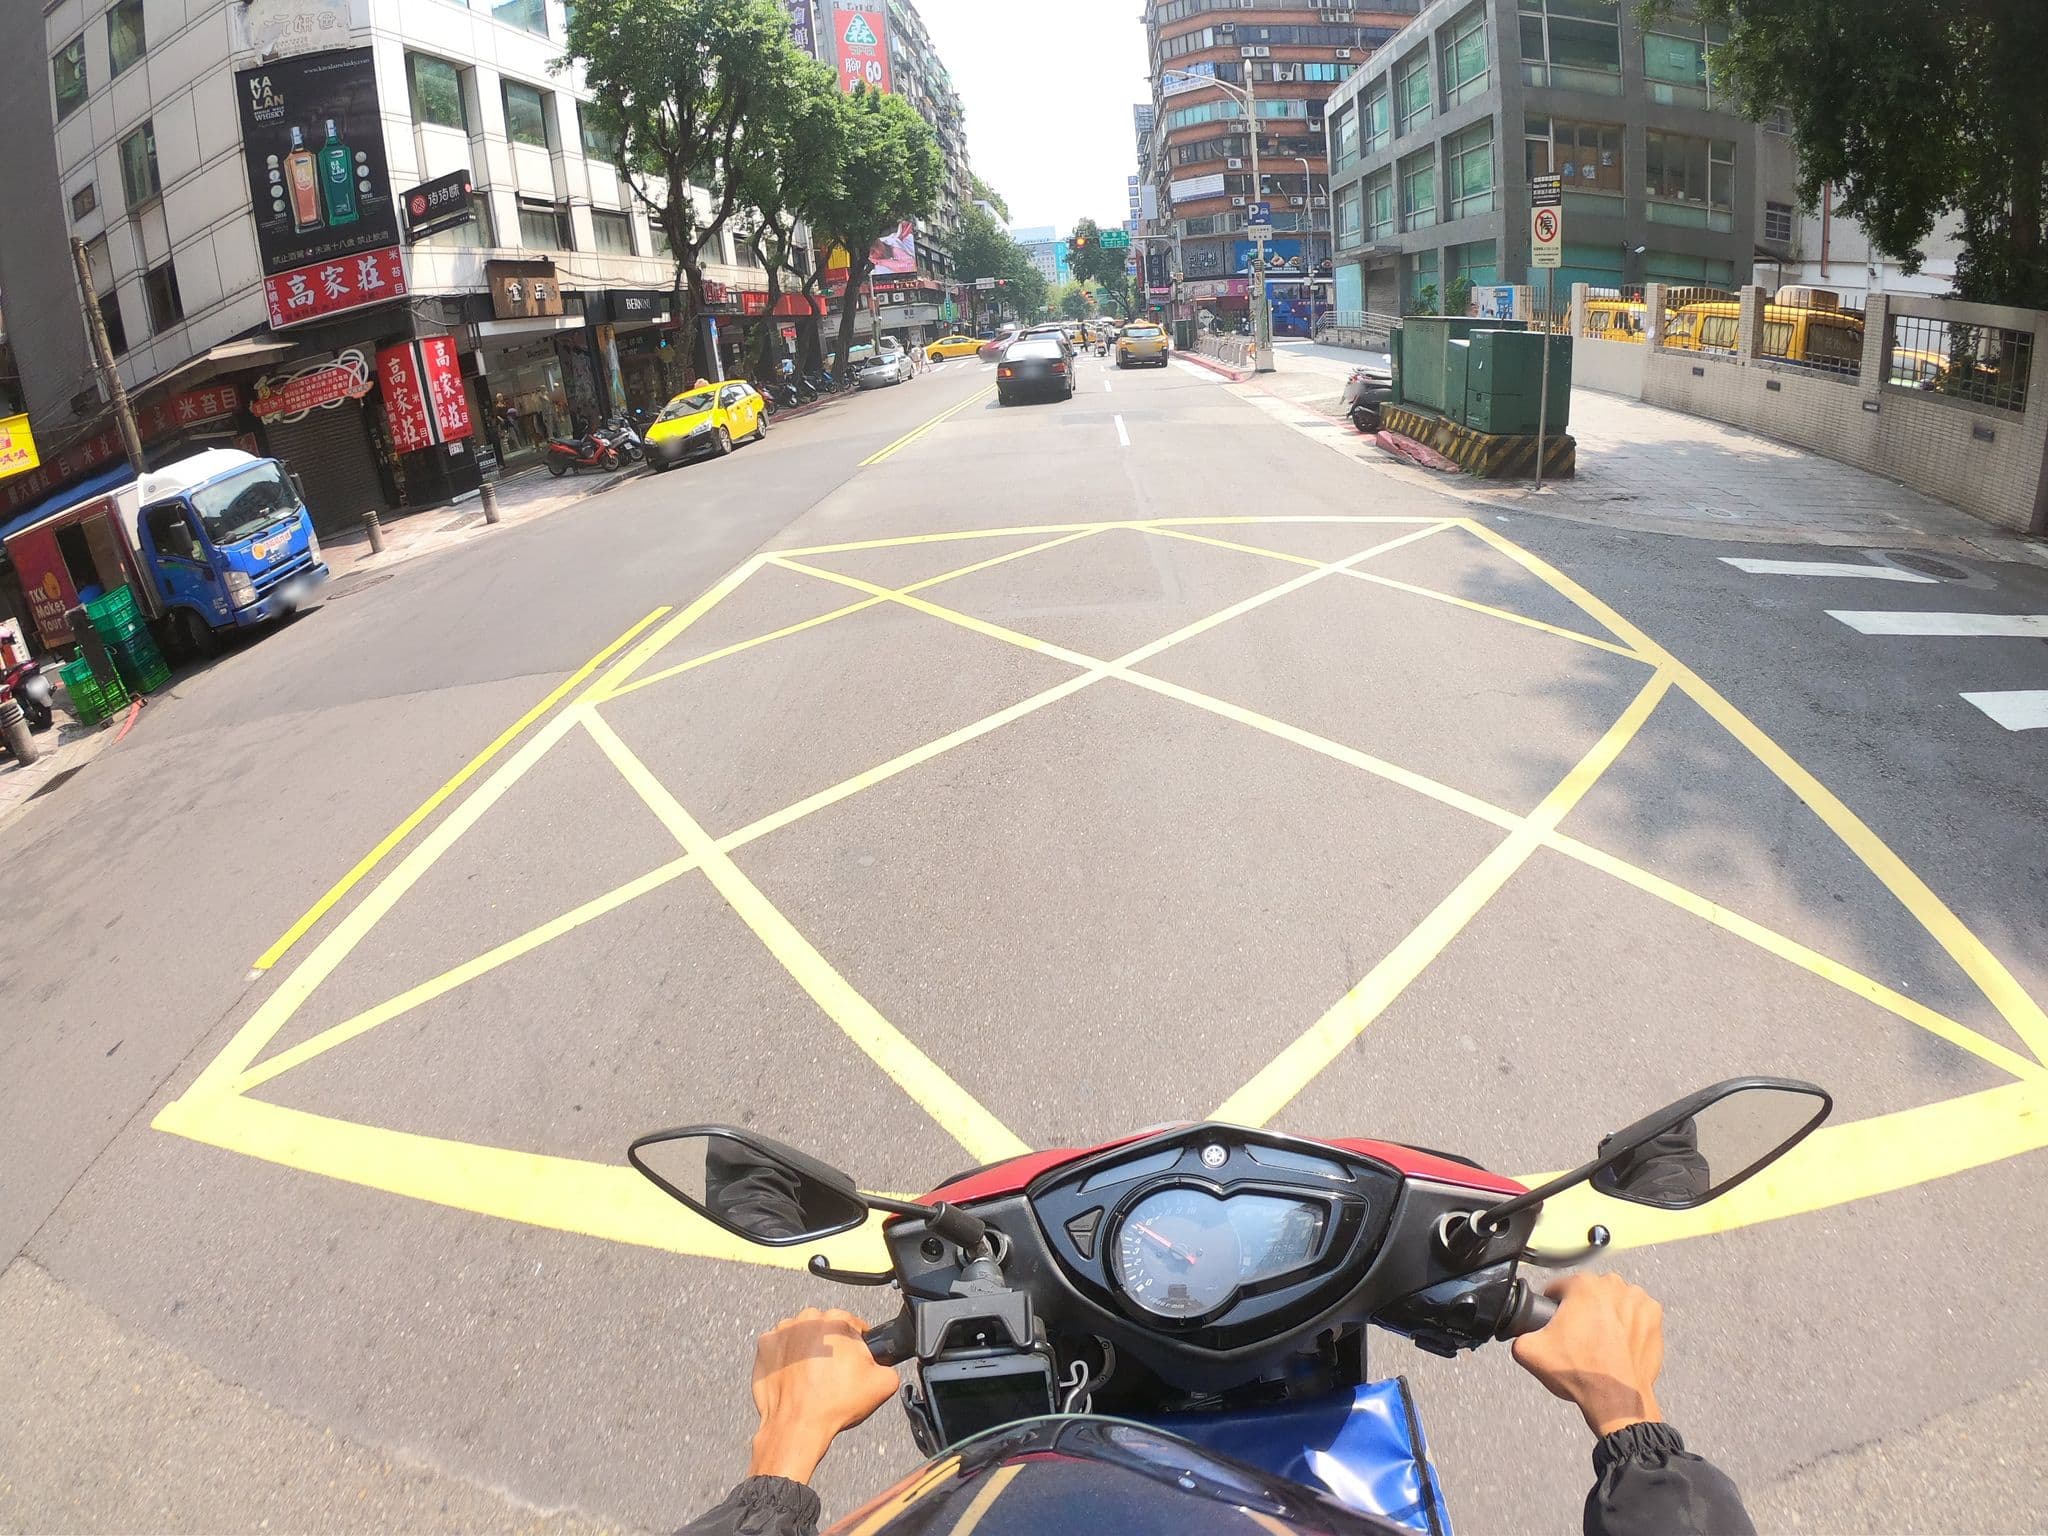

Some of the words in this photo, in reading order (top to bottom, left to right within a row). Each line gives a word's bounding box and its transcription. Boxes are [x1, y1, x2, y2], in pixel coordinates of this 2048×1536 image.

[865, 60, 882, 82] 60
[252, 94, 284, 110] LAN
[254, 109, 285, 121] WHISKY
[1248, 204, 1260, 220] P
[1539, 215, 1553, 236] 停
[286, 255, 385, 309] 高家莊
[388, 249, 405, 295] 米苔目
[434, 340, 464, 430] 高家莊
[179, 387, 238, 420] 米苔目
[387, 356, 421, 446] 高家莊
[29, 586, 48, 604] TKK
[35, 600, 66, 619] Makes
[40, 618, 63, 632] Your
